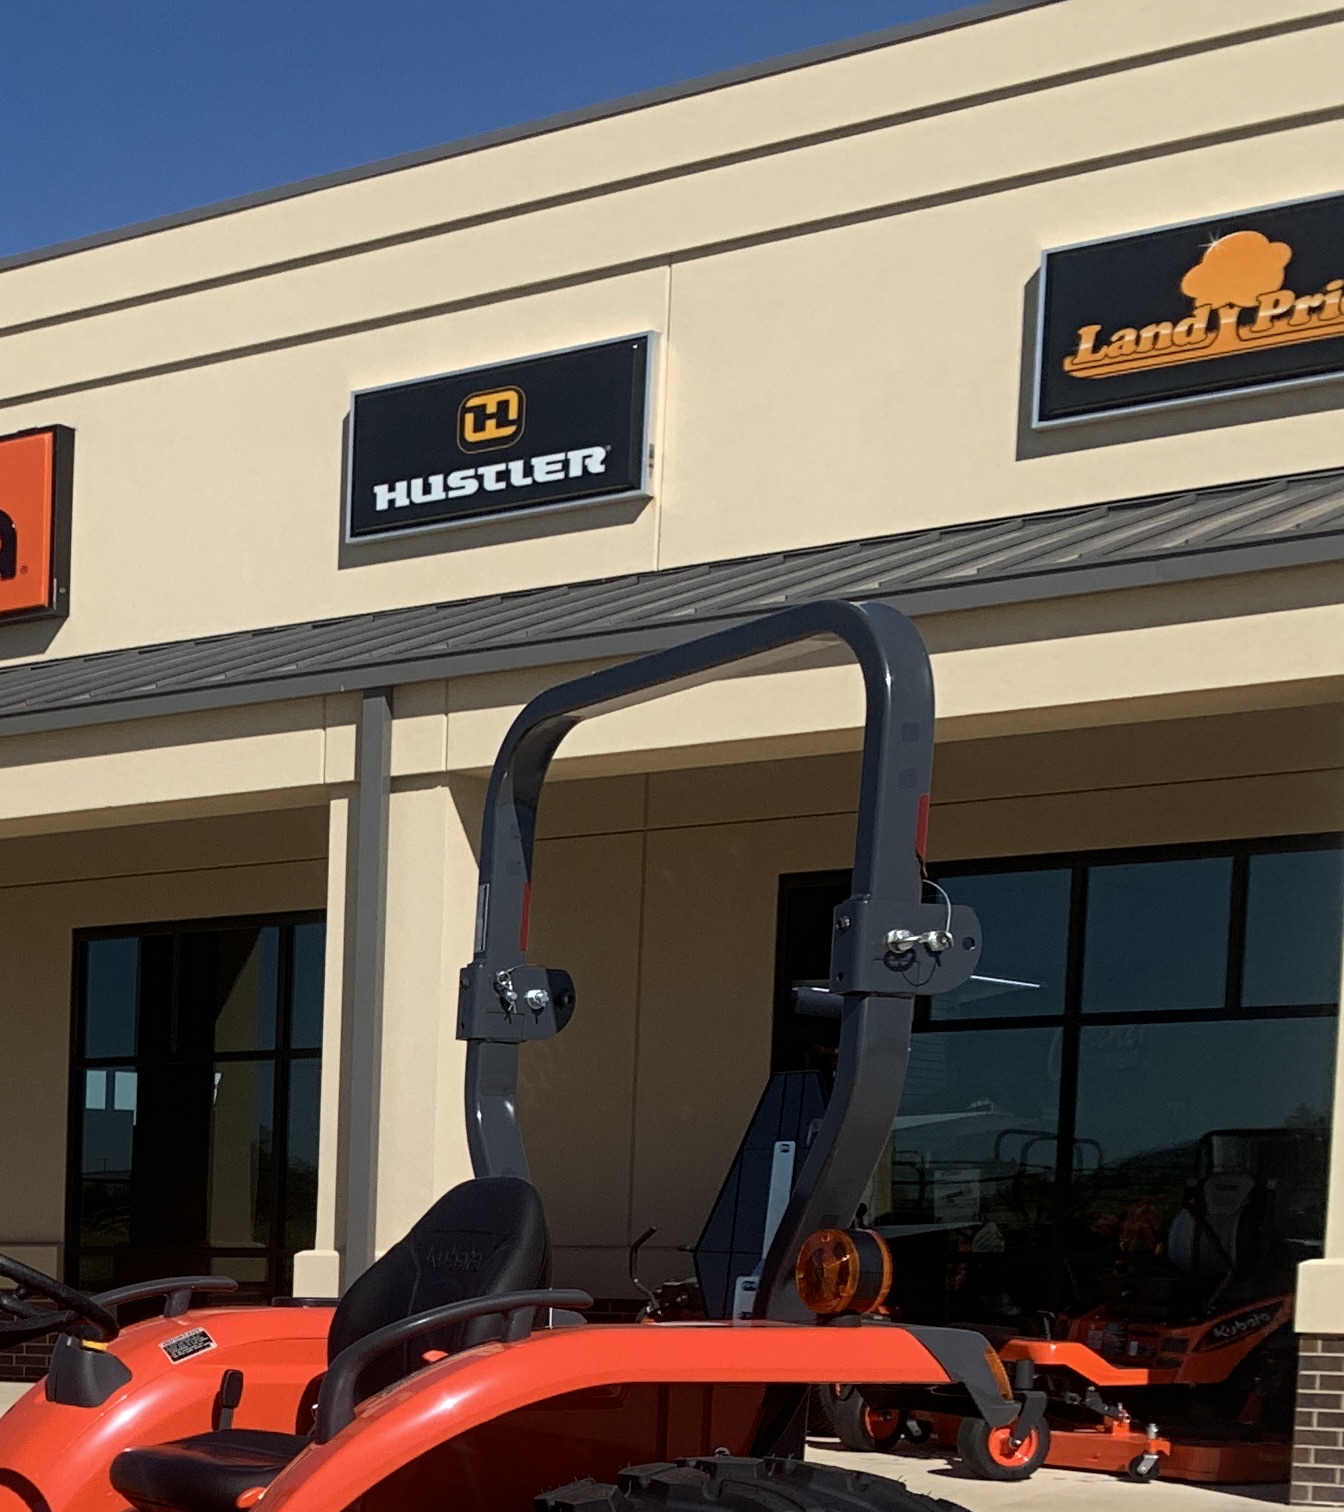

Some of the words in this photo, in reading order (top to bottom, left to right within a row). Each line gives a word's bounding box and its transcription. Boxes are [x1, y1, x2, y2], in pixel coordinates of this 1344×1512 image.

[1072, 303, 1215, 365] Land
[1250, 279, 1344, 333] Pri
[374, 446, 608, 511] HUSTLER
[1213, 1312, 1271, 1337] Kubota
